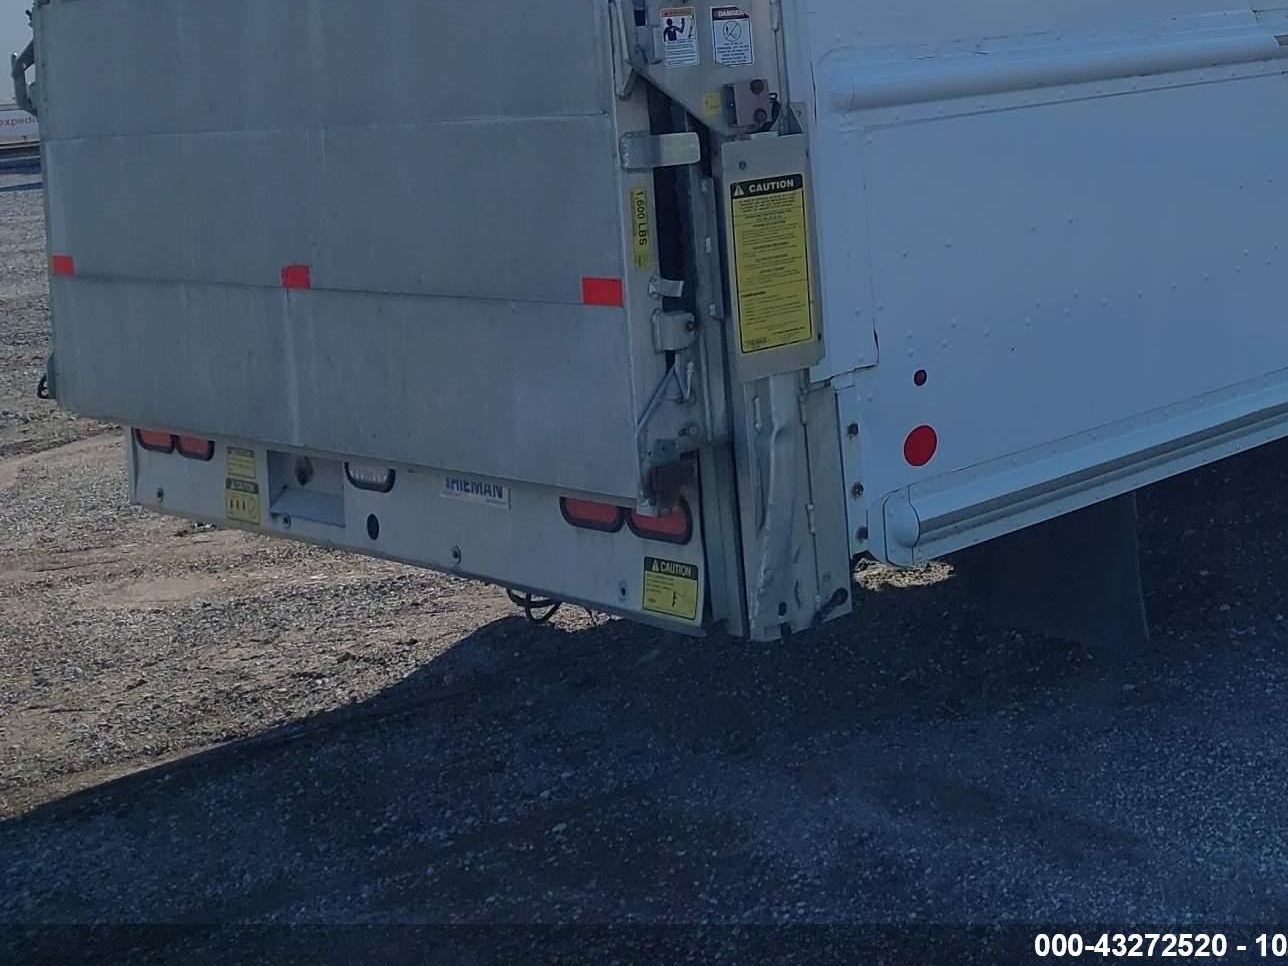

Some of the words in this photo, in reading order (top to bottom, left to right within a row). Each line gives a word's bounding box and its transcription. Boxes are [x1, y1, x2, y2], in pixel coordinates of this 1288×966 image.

[749, 178, 795, 193] CAUTION
[638, 222, 648, 246] LBS
[660, 560, 692, 577] CAUTION
